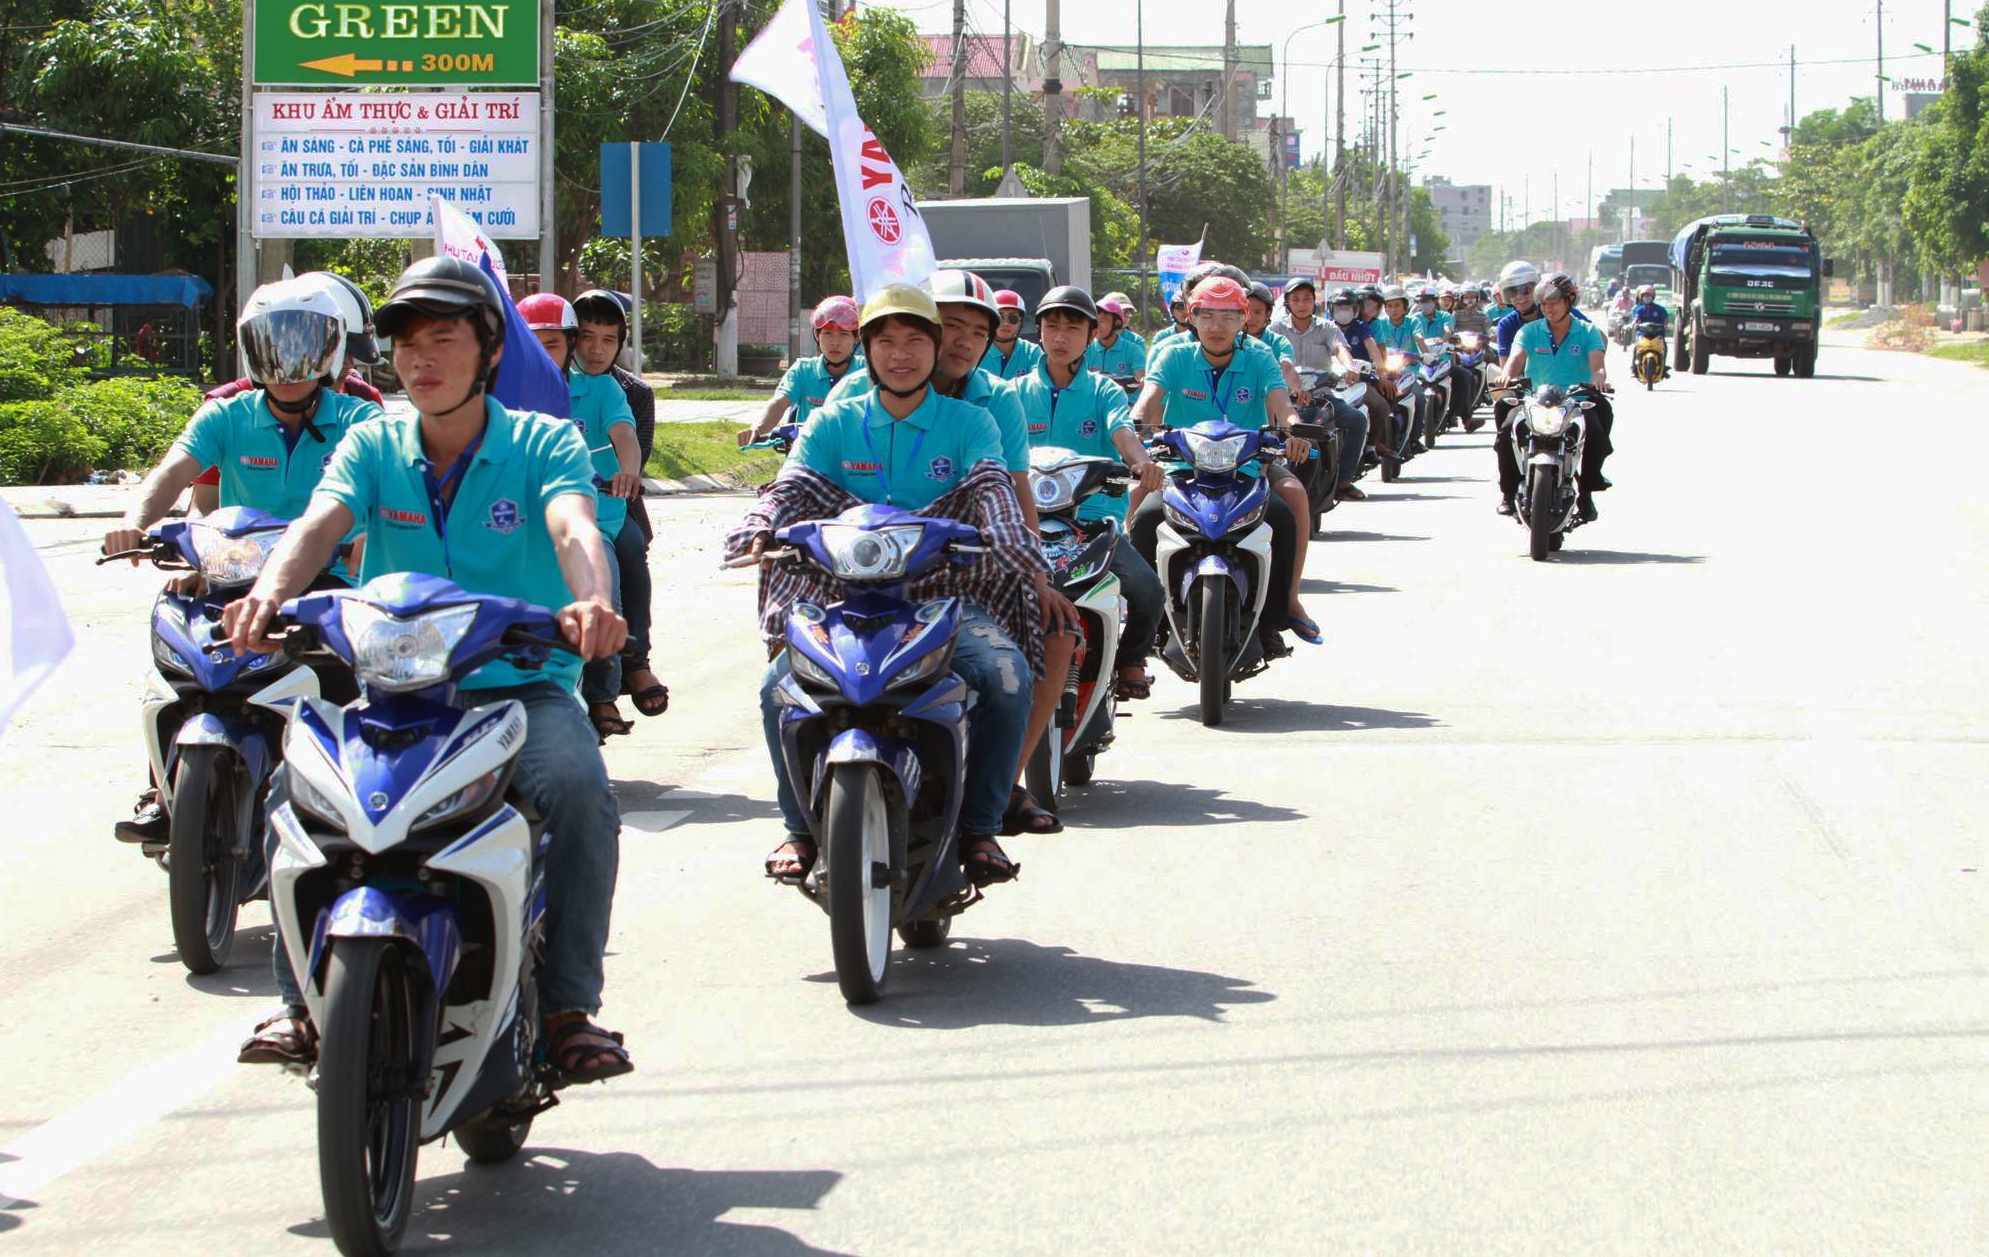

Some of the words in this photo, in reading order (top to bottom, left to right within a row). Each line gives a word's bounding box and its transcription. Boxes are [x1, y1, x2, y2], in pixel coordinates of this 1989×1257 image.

[289, 3, 509, 38] GREEN
[421, 53, 494, 71] 300M
[272, 103, 316, 119] KHU
[321, 96, 352, 119] ẨM
[360, 101, 411, 123] THỰC
[417, 106, 429, 119] &
[435, 95, 479, 119] GIẢI
[485, 97, 520, 119] TRÍ
[280, 136, 298, 153] ĂN
[302, 136, 335, 153] SÁNG
[348, 136, 364, 153] CÀ
[369, 136, 392, 153] PHÊ
[396, 136, 433, 154] SÁNG,
[437, 134, 456, 153] TỐI
[469, 134, 493, 153] GIẢI
[498, 136, 529, 153] KHÁT
[280, 161, 298, 177] ĂN
[340, 159, 358, 177] TỐI
[400, 158, 425, 177] SẢN
[430, 160, 458, 177] BÌNH
[463, 161, 488, 177] DÂN
[281, 184, 300, 204] HỘI
[305, 181, 335, 201] THẢO
[349, 184, 375, 201] LIÊN
[380, 187, 413, 201] HOAN
[460, 184, 492, 204] NHẬT
[281, 207, 305, 225] CÂU
[309, 207, 325, 225] CÁ
[329, 205, 354, 225] GIẢI
[357, 206, 376, 225] TRÍ
[390, 211, 421, 228] CHỤP
[487, 207, 515, 226] CƯỚI
